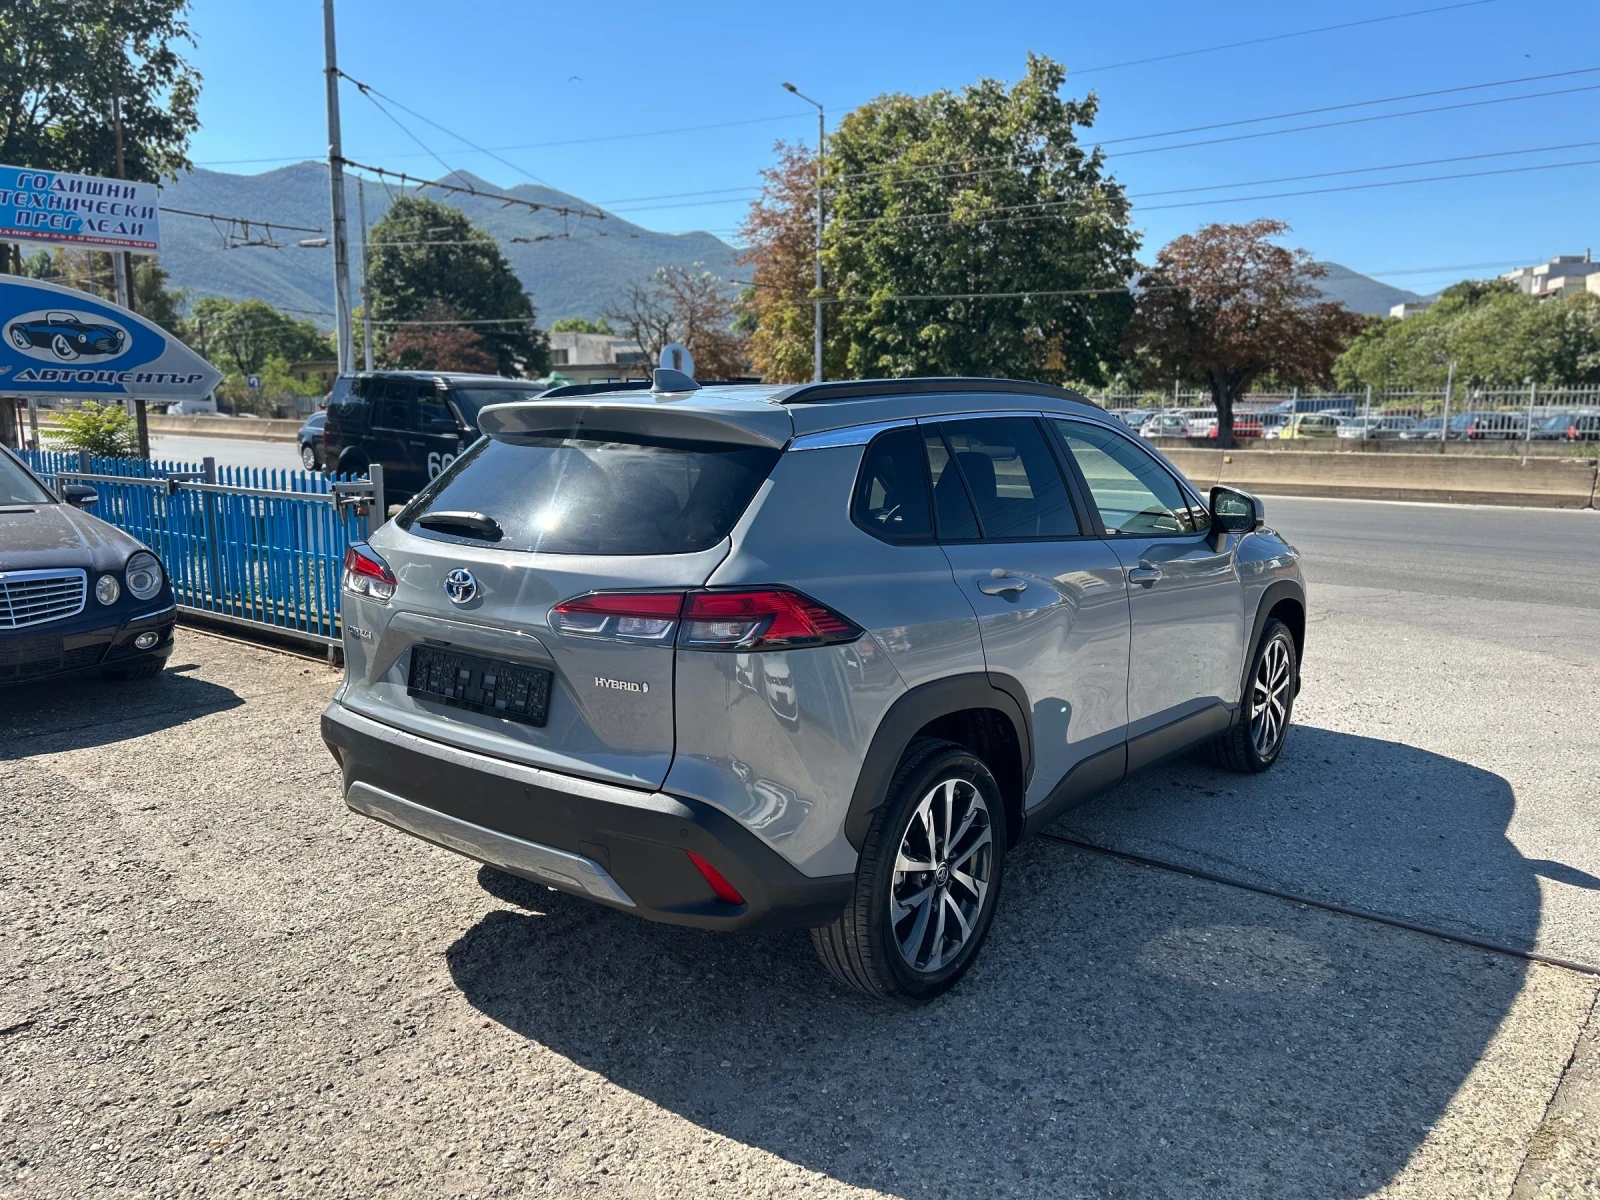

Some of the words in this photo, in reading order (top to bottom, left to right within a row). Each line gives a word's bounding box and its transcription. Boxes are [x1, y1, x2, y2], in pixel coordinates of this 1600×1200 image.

[17, 173, 136, 200] ГОДИШНИ
[0, 190, 154, 220] ТЕХНИЧЕСКИ
[13, 368, 203, 385] АВТОЦЕНТЪР
[594, 677, 641, 692] HYBRID
